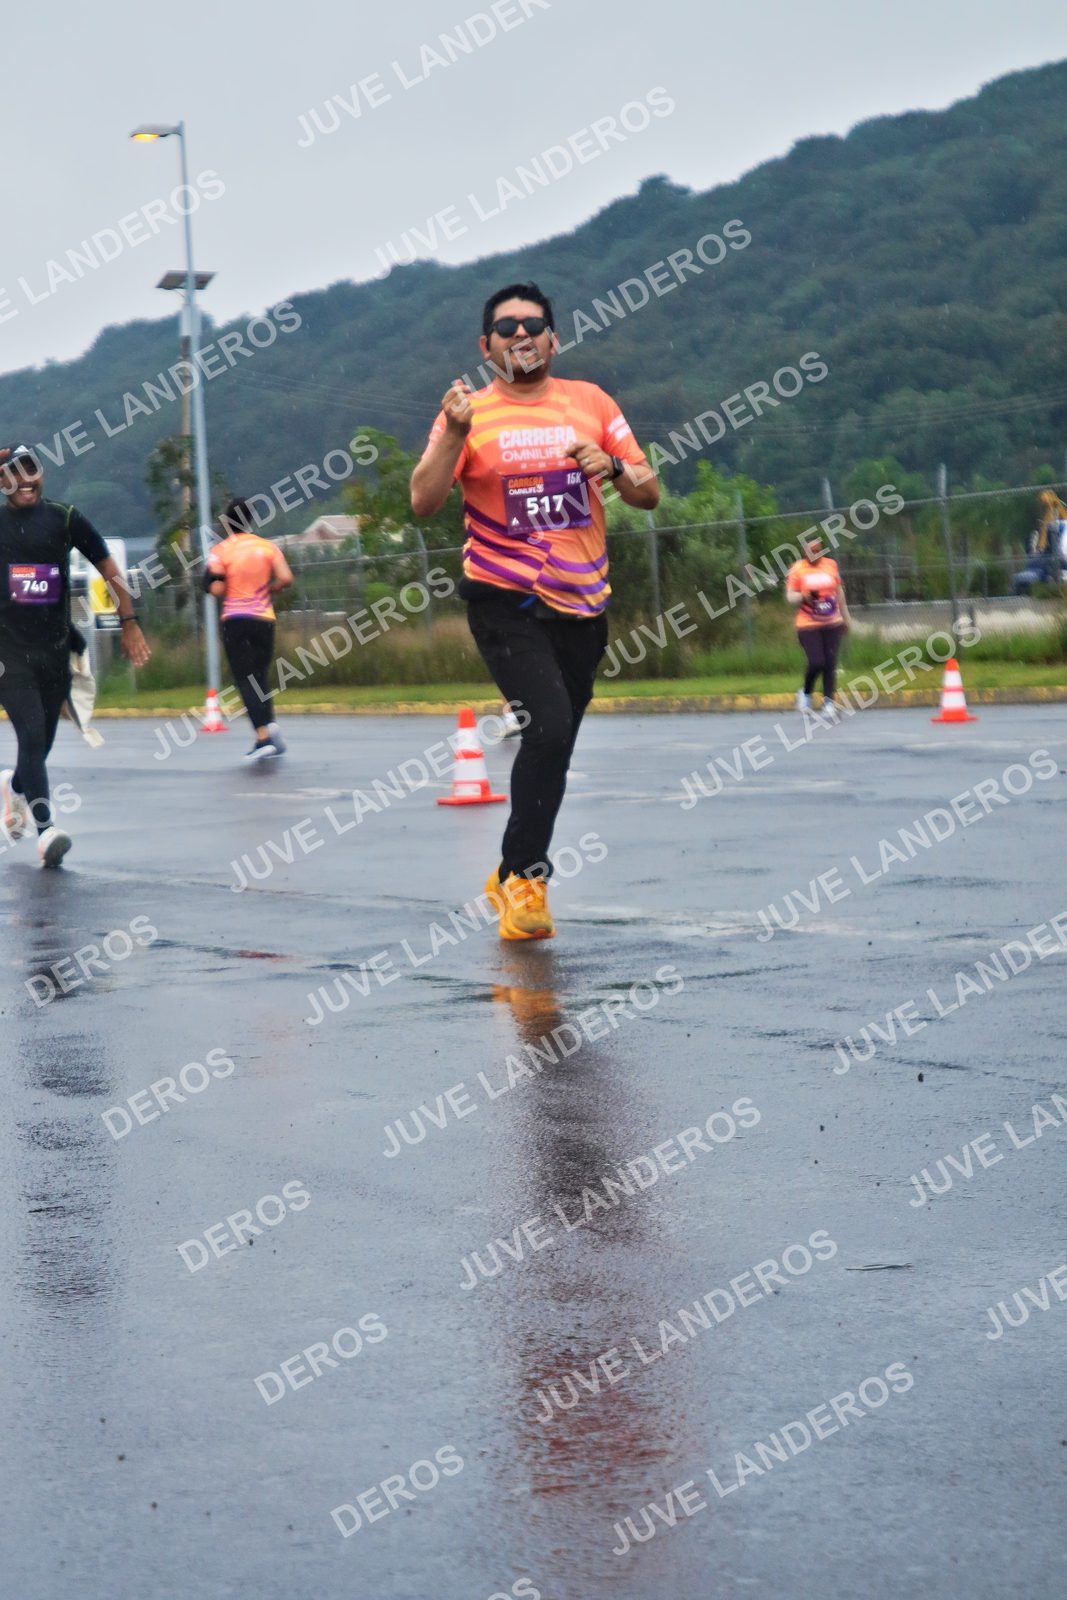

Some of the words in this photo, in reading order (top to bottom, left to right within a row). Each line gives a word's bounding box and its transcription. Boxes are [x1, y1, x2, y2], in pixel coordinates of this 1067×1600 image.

[499, 425, 577, 449] CARRERA
[566, 472, 582, 485] 15K
[526, 494, 564, 515] 517
[22, 580, 48, 592] 740
